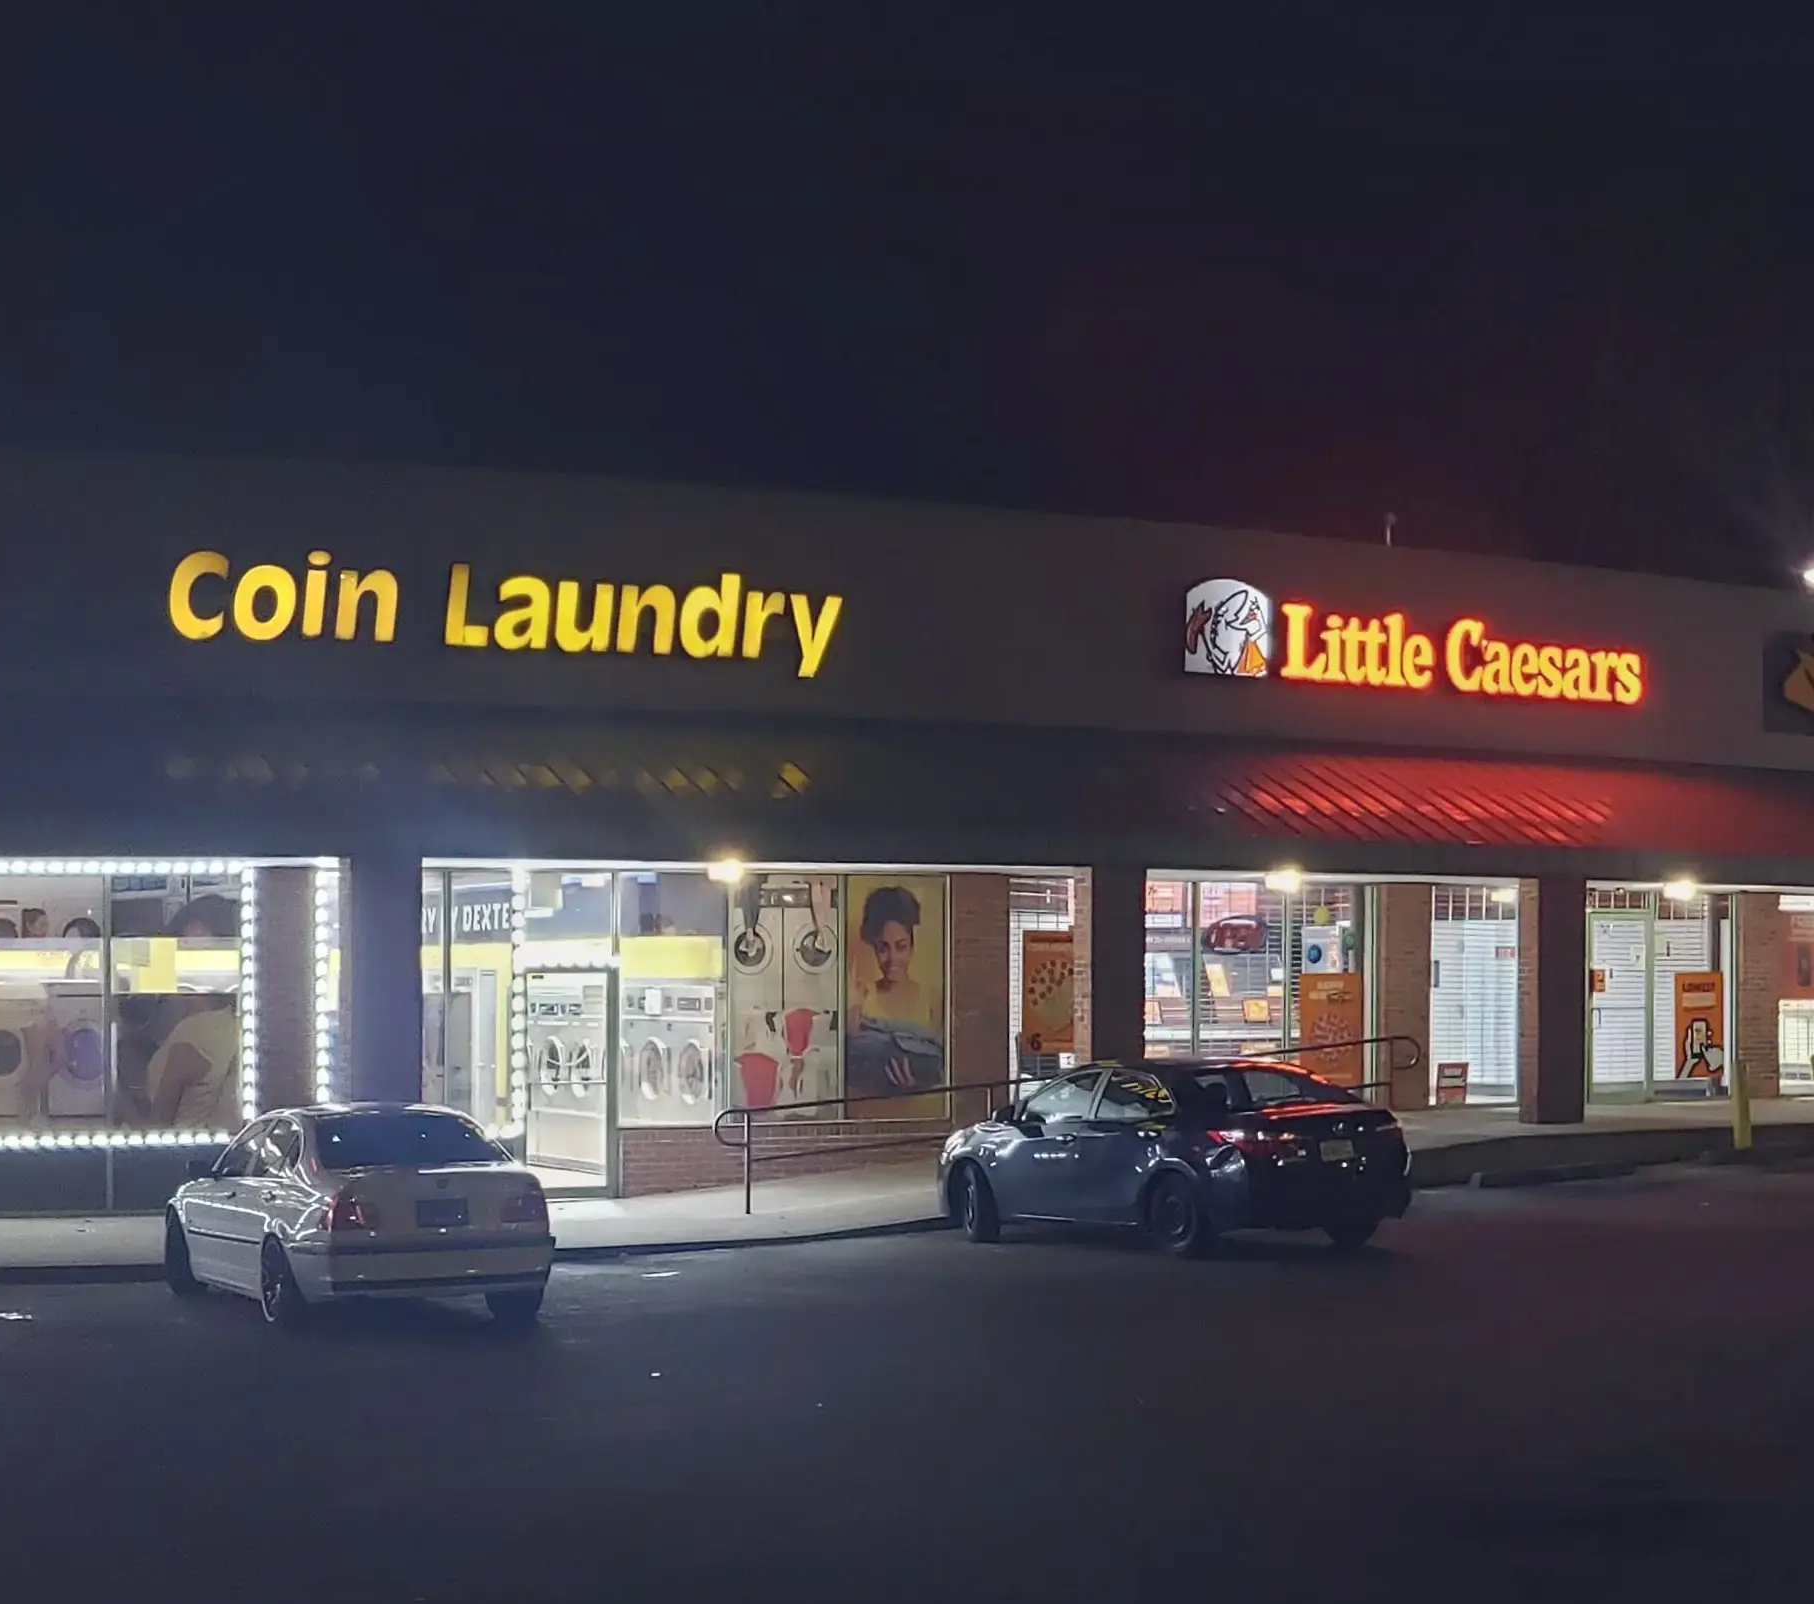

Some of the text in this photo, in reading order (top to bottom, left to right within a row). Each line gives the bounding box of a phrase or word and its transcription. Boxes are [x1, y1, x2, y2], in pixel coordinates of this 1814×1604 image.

[169, 549, 843, 678] Coin Laundry
[1279, 602, 1643, 706] Little Caesars
